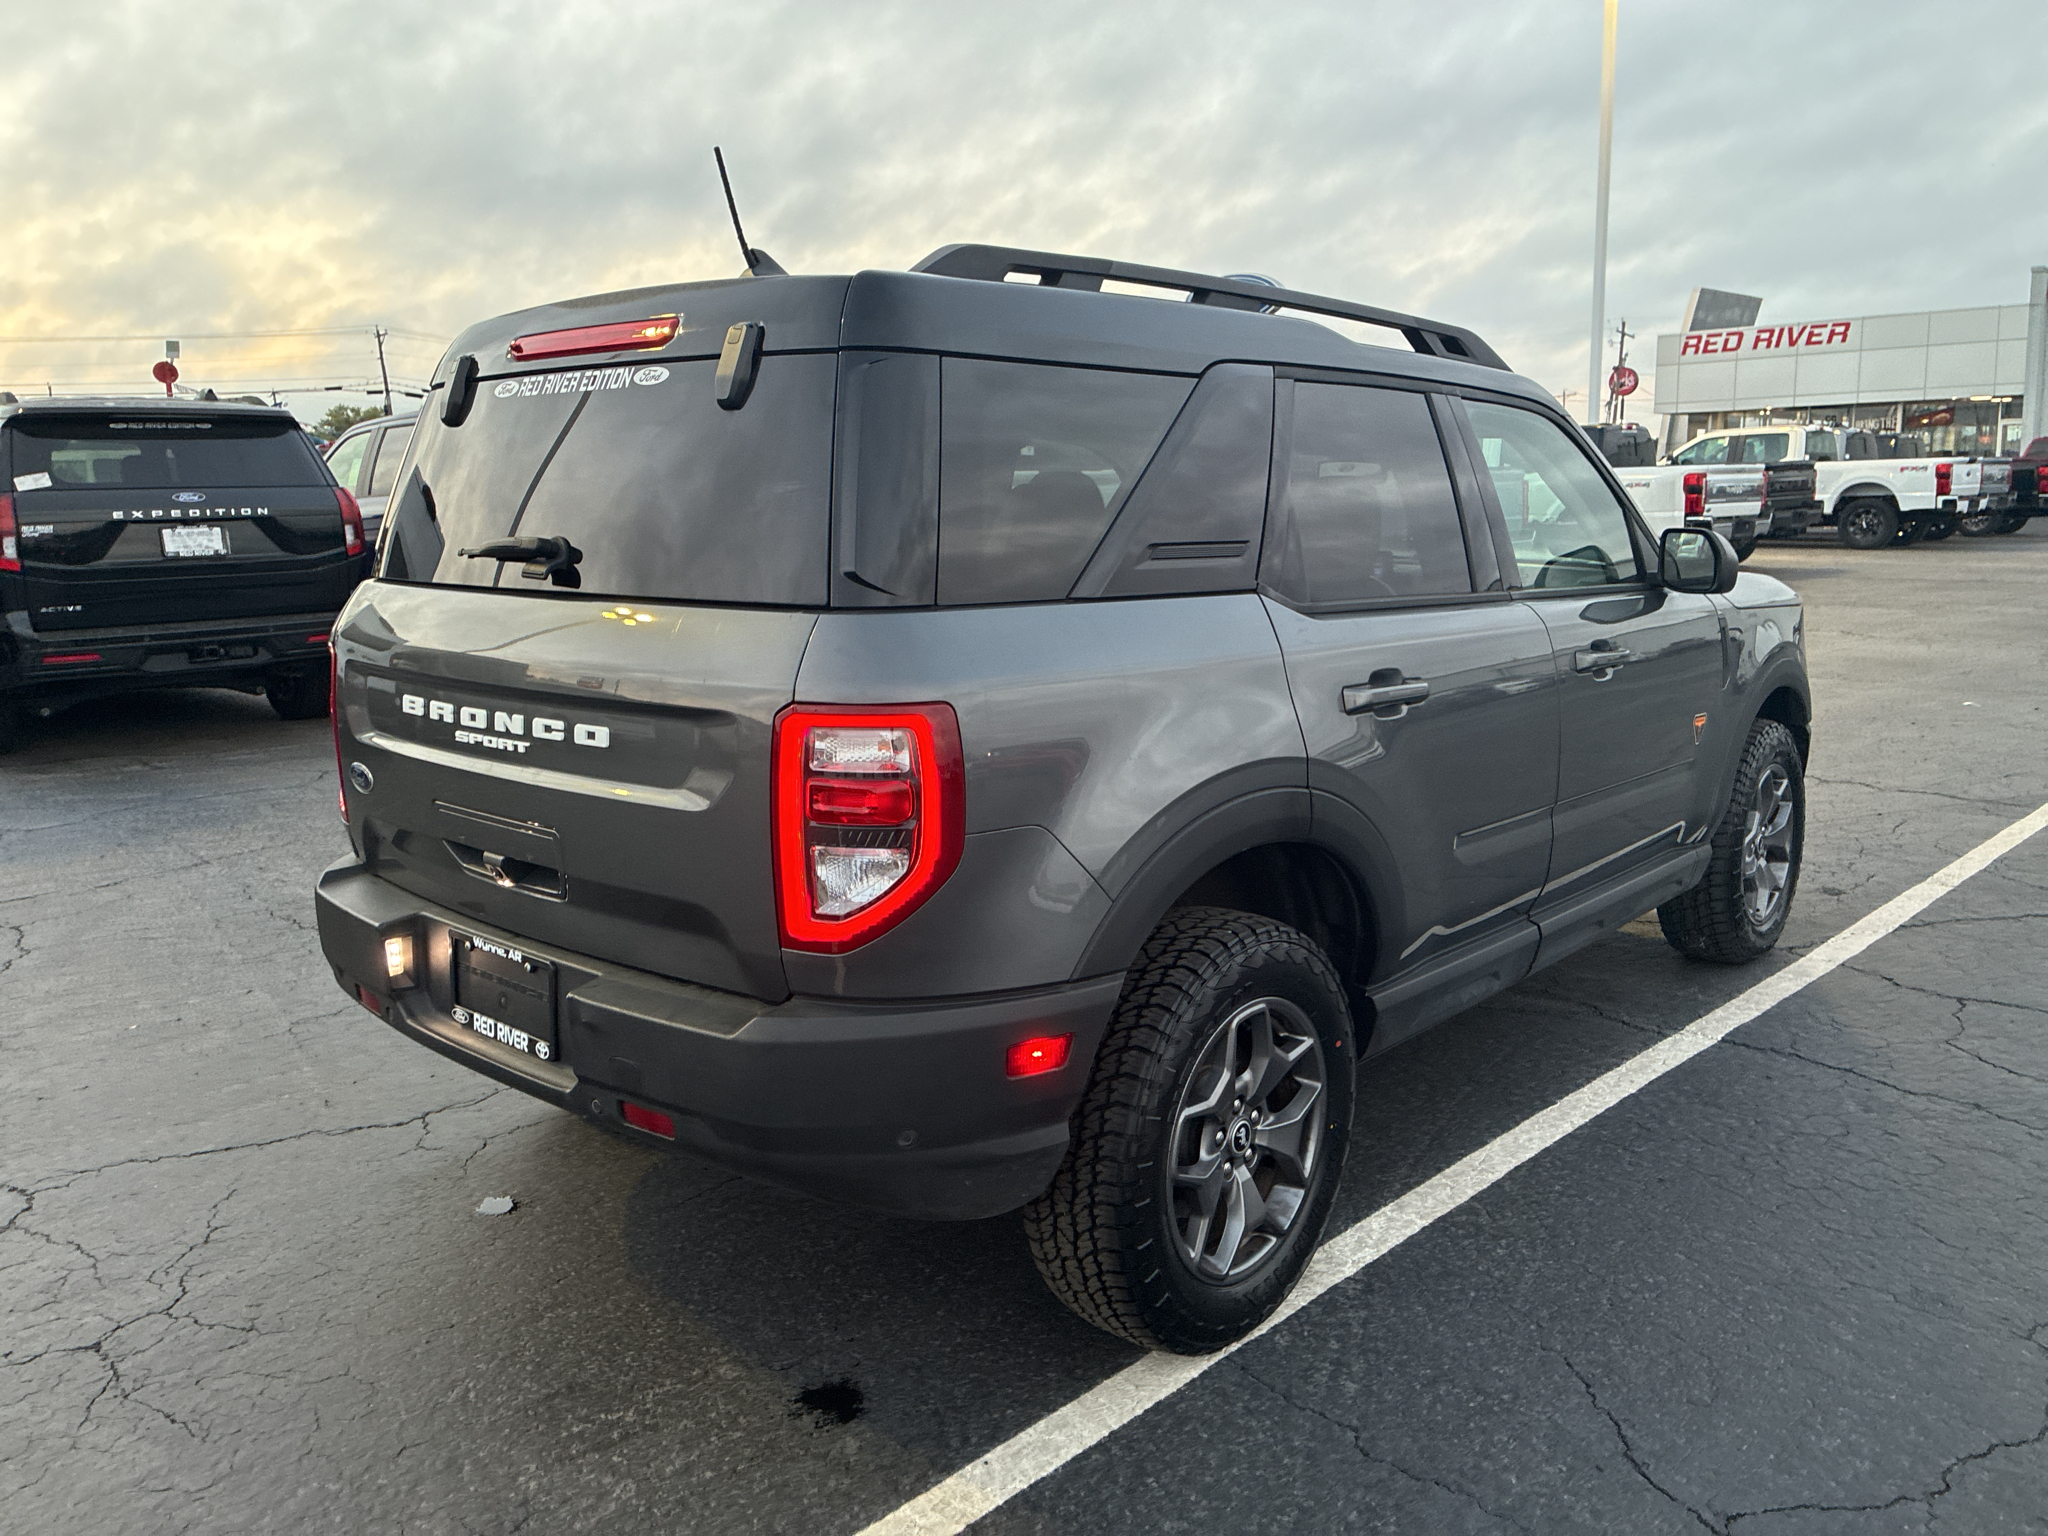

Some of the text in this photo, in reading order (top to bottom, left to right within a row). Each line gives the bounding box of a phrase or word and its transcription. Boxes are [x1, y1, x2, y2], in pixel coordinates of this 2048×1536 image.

[1681, 322, 1852, 356] RED RIVER
[497, 367, 665, 397] Ford RED RIVER EDITION Ford
[112, 507, 269, 520] EXPEDITION
[40, 604, 82, 613] ACTIVE
[402, 694, 610, 748] BRONCO
[455, 730, 531, 753] SPORT
[473, 936, 522, 963] Wynne, AR
[473, 1012, 495, 1038] RED
[497, 1022, 529, 1053] RIVER
